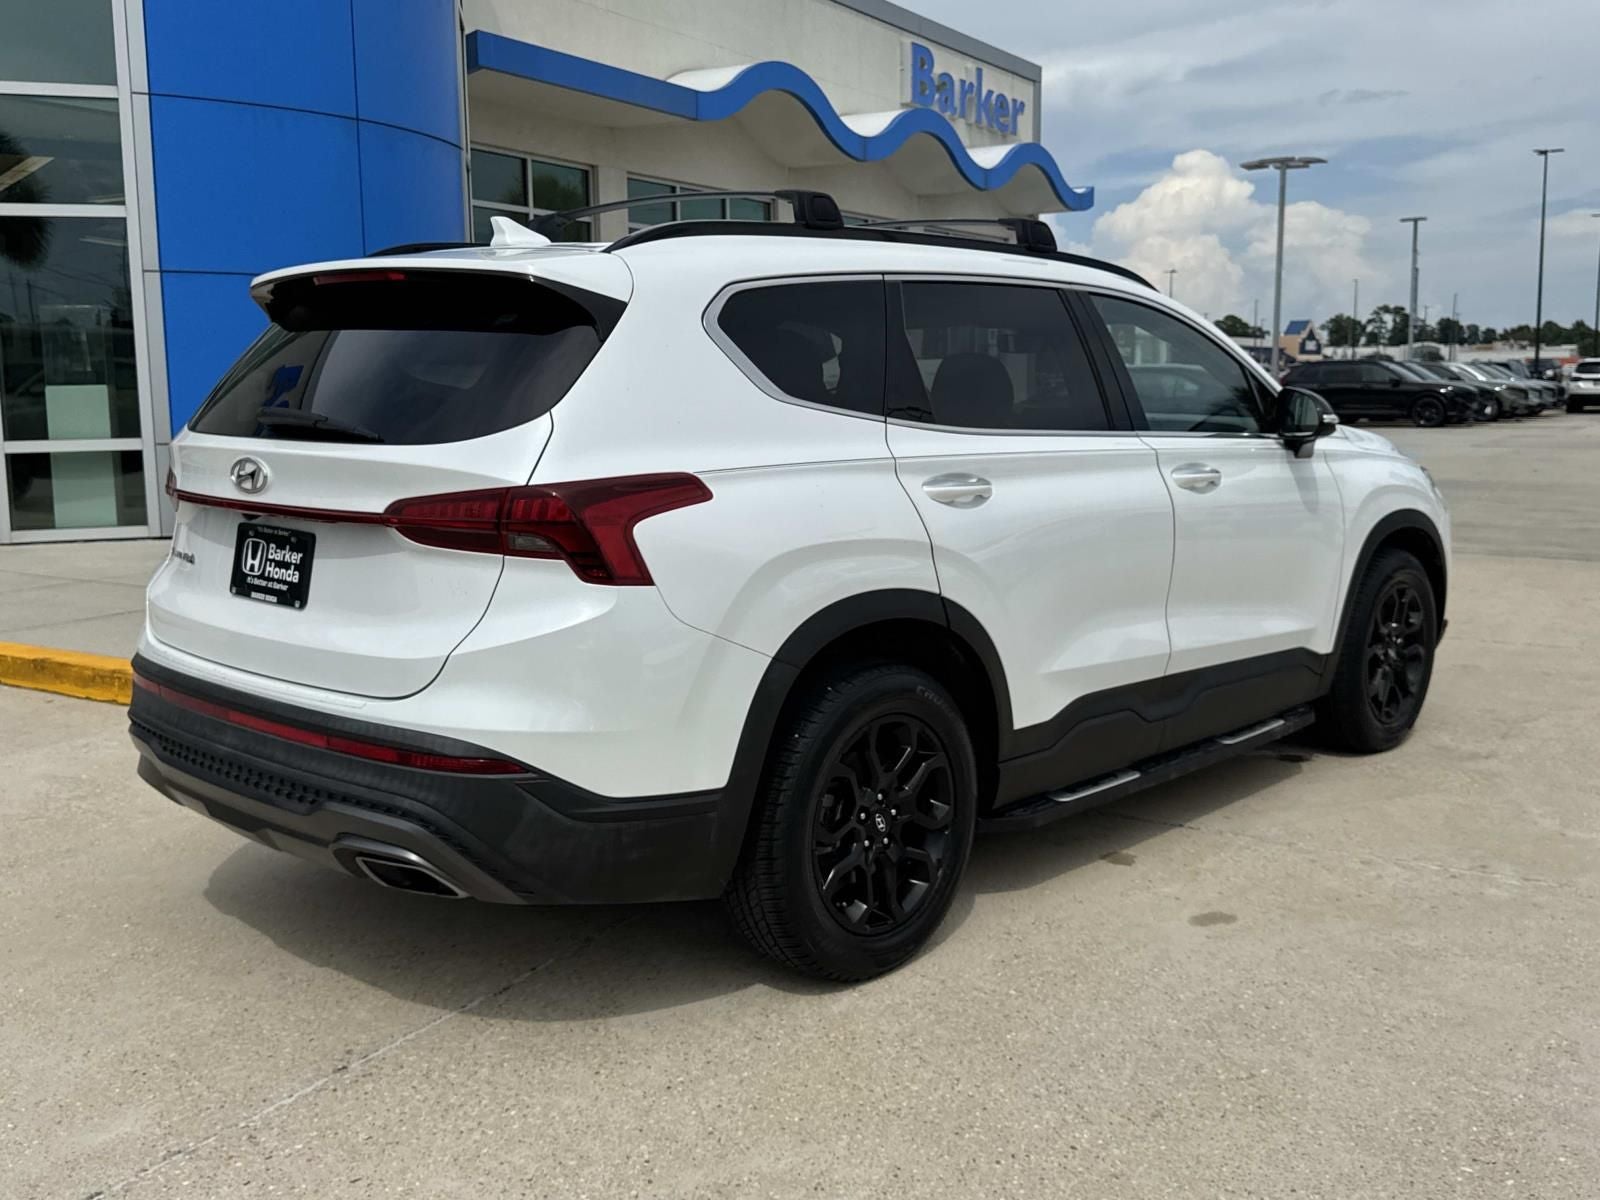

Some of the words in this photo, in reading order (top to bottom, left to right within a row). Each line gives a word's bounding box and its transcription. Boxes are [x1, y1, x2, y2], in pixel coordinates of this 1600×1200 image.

[911, 41, 1025, 135] Barker
[268, 543, 303, 564] Barker
[265, 561, 299, 583] Honda
